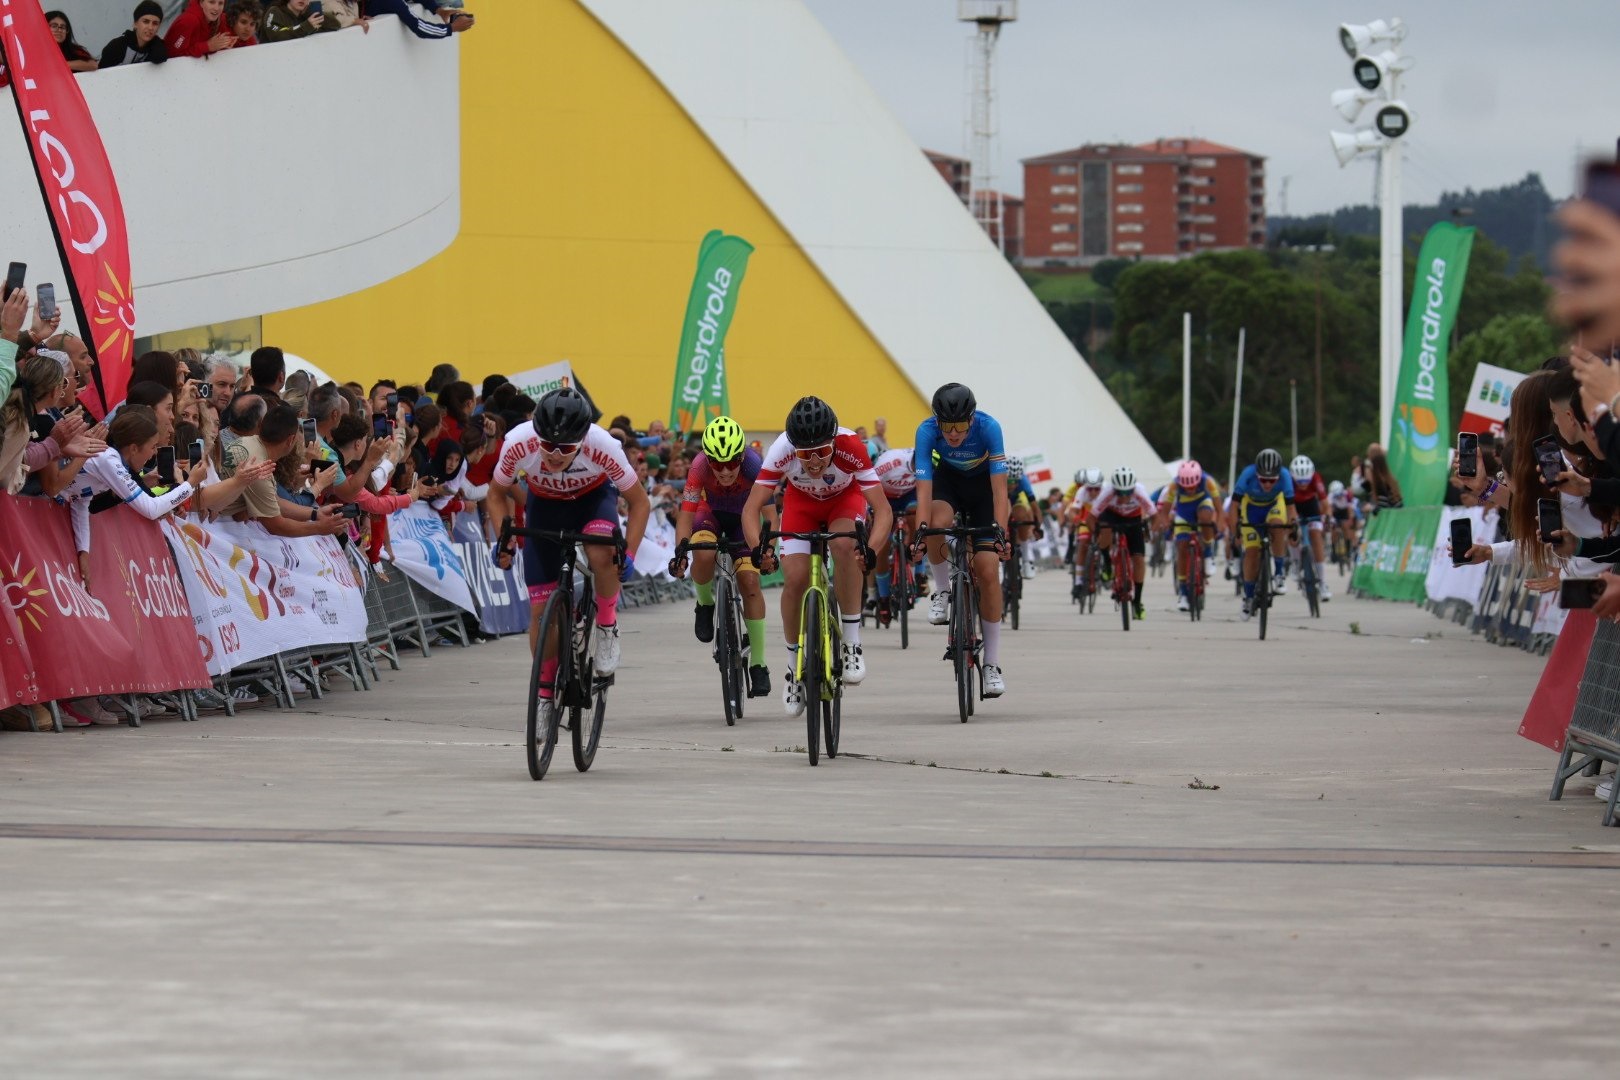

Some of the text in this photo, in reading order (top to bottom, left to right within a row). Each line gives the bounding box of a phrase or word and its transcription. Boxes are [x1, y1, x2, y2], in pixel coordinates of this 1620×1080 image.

[682, 266, 732, 404] Iberdrola
[1413, 257, 1446, 401] Iberdrola
[500, 441, 526, 478] MADRID
[591, 448, 626, 481] MADRID
[128, 556, 189, 619] Cofidis
